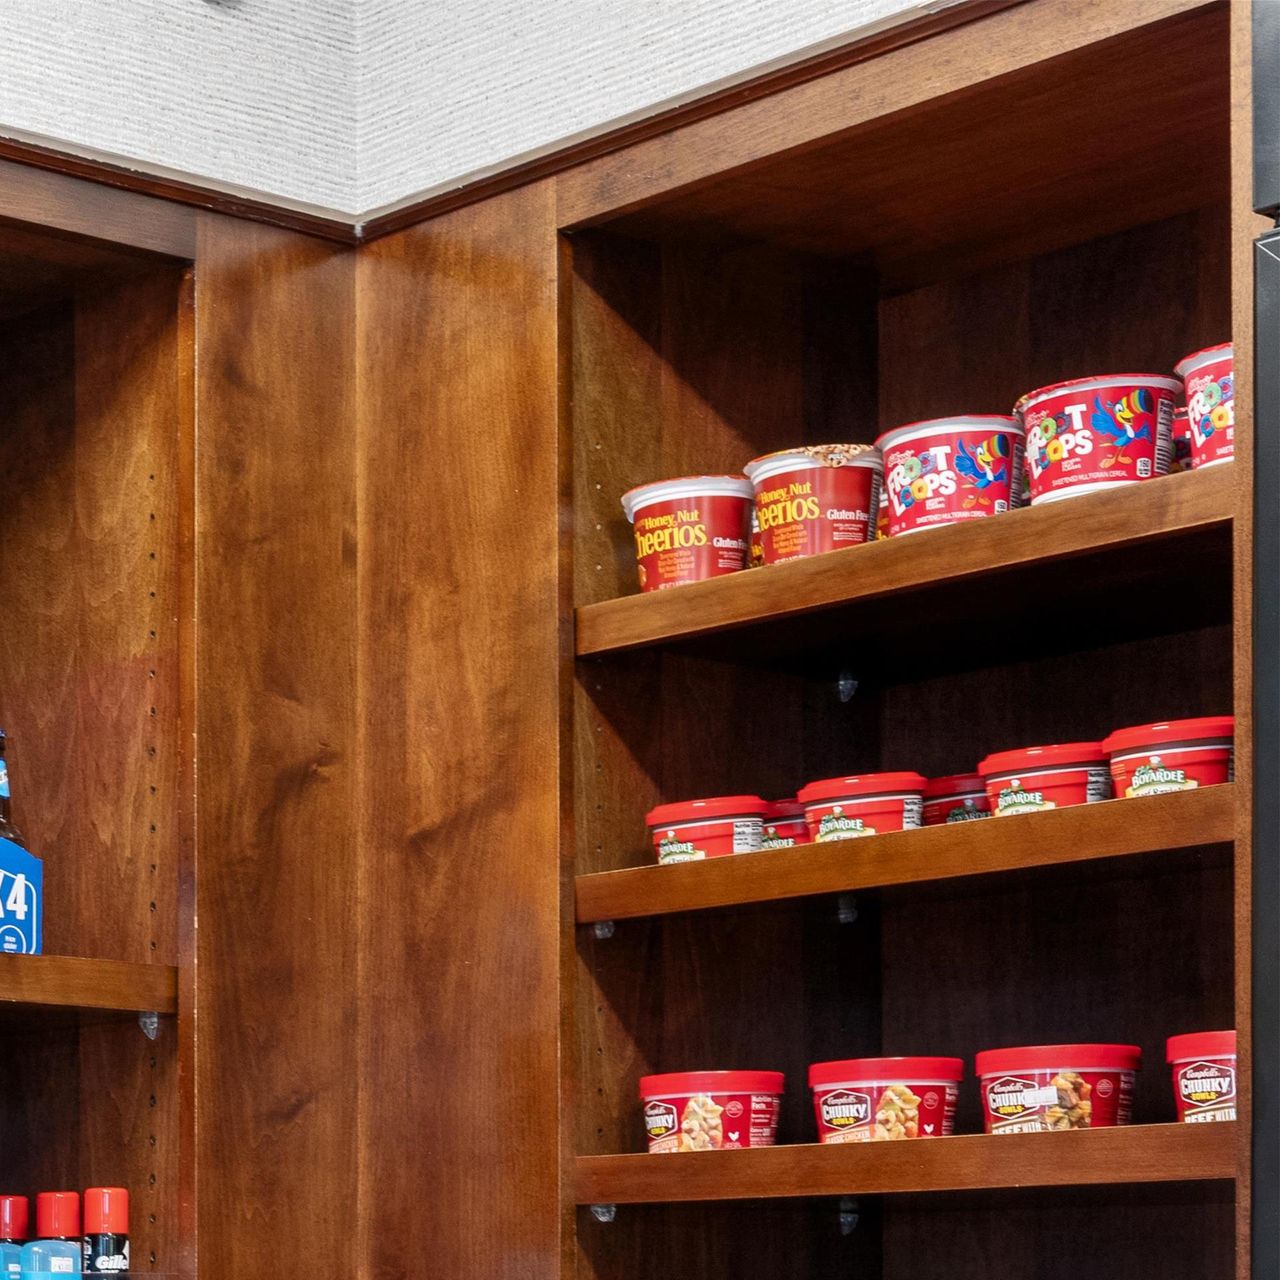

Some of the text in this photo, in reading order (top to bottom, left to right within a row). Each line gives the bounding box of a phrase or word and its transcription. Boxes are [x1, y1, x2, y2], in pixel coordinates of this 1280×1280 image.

[887, 445, 951, 495] FROOT
[894, 473, 957, 518] LOOPS
[645, 510, 699, 530] Honey Nut
[1131, 770, 1185, 789] BOYARDEE
[6, 874, 28, 921] 4
[1180, 1078, 1230, 1094] CHUNKY
